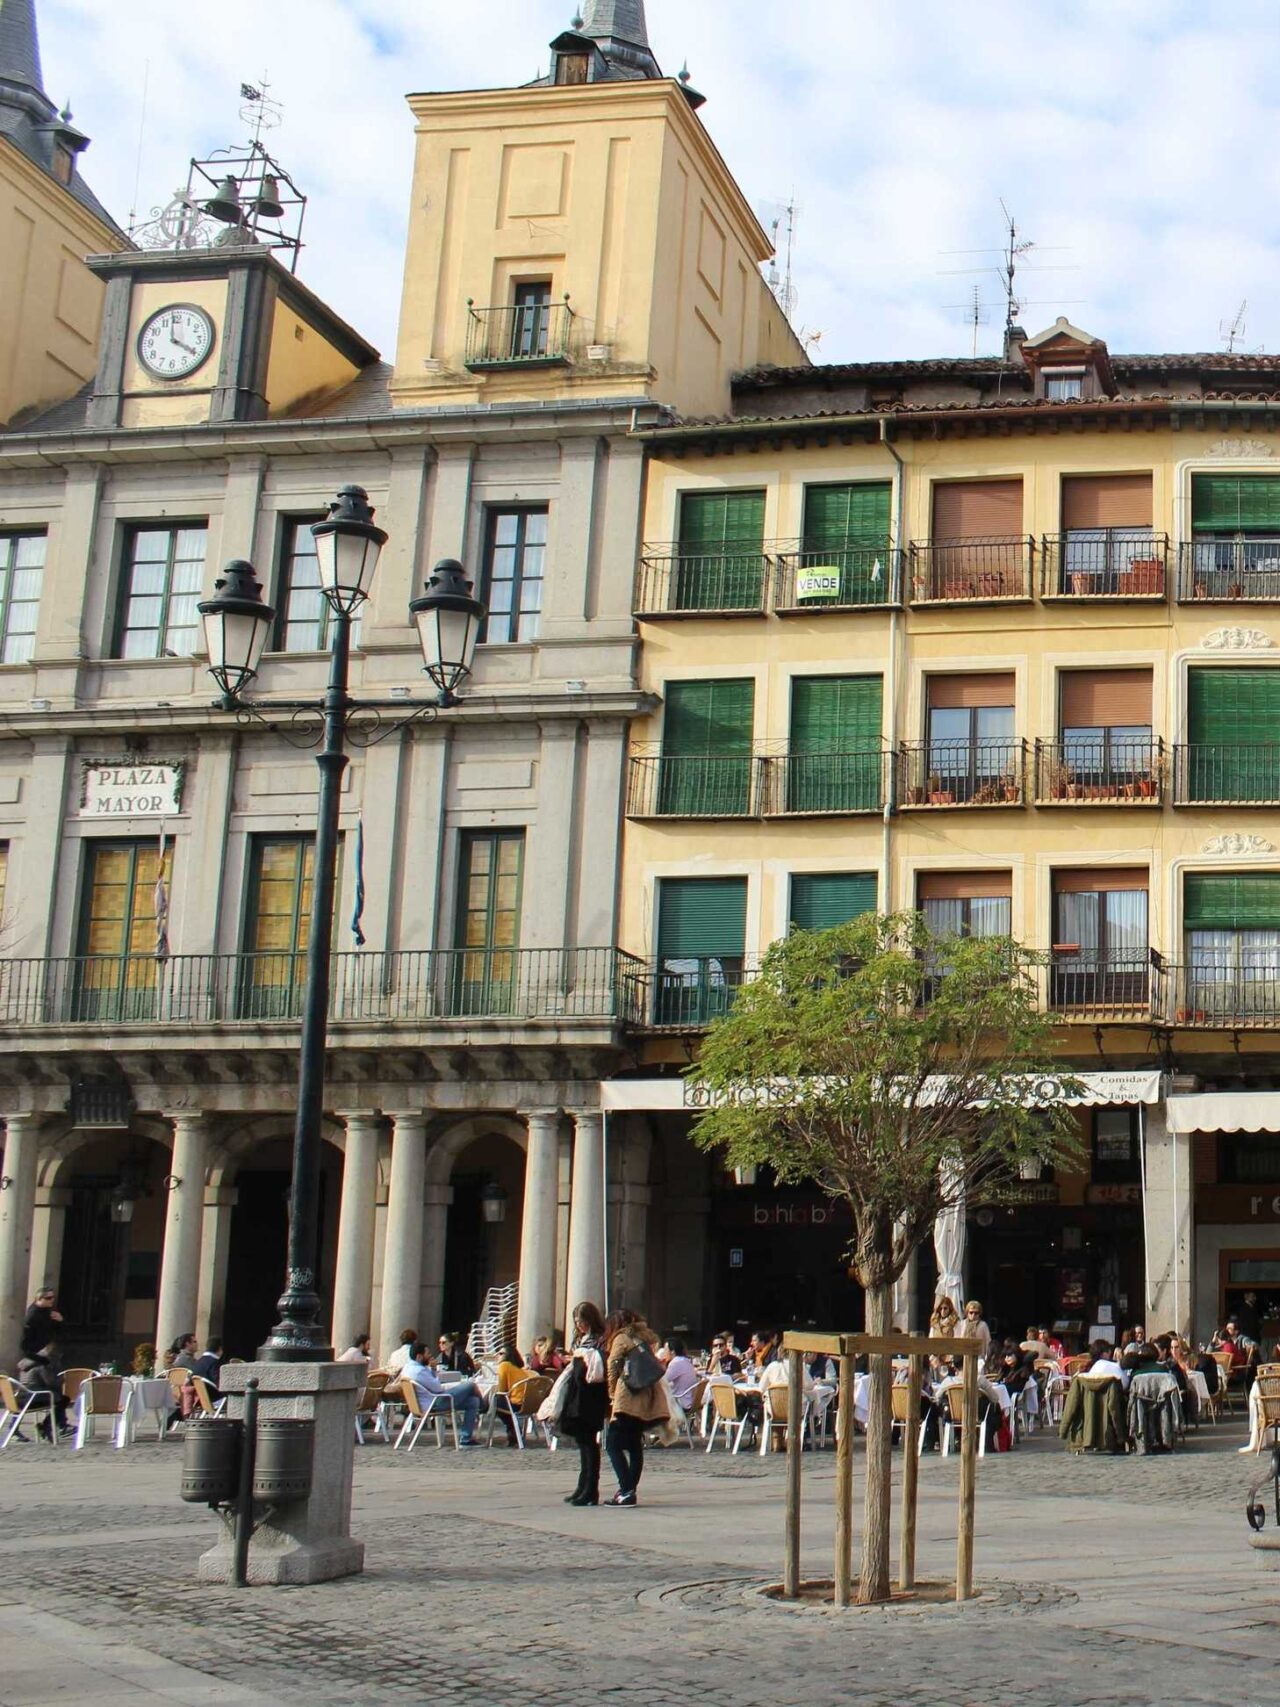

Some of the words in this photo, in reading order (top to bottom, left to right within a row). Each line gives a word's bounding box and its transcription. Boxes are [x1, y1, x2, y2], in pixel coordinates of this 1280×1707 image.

[162, 319, 169, 328] 11
[193, 323, 200, 334] 2
[152, 327, 161, 336] 10
[148, 338, 154, 348] 9
[195, 335, 202, 345] 3
[150, 350, 157, 360] 8
[159, 357, 165, 368] 7
[169, 359, 175, 369] 6
[180, 356, 187, 366] 5
[800, 577, 837, 590] VENDE
[99, 769, 167, 786] PLAZA
[96, 796, 162, 812] MAYOR
[1100, 1075, 1148, 1084] Comidas
[1109, 1092, 1139, 1102] Tapas
